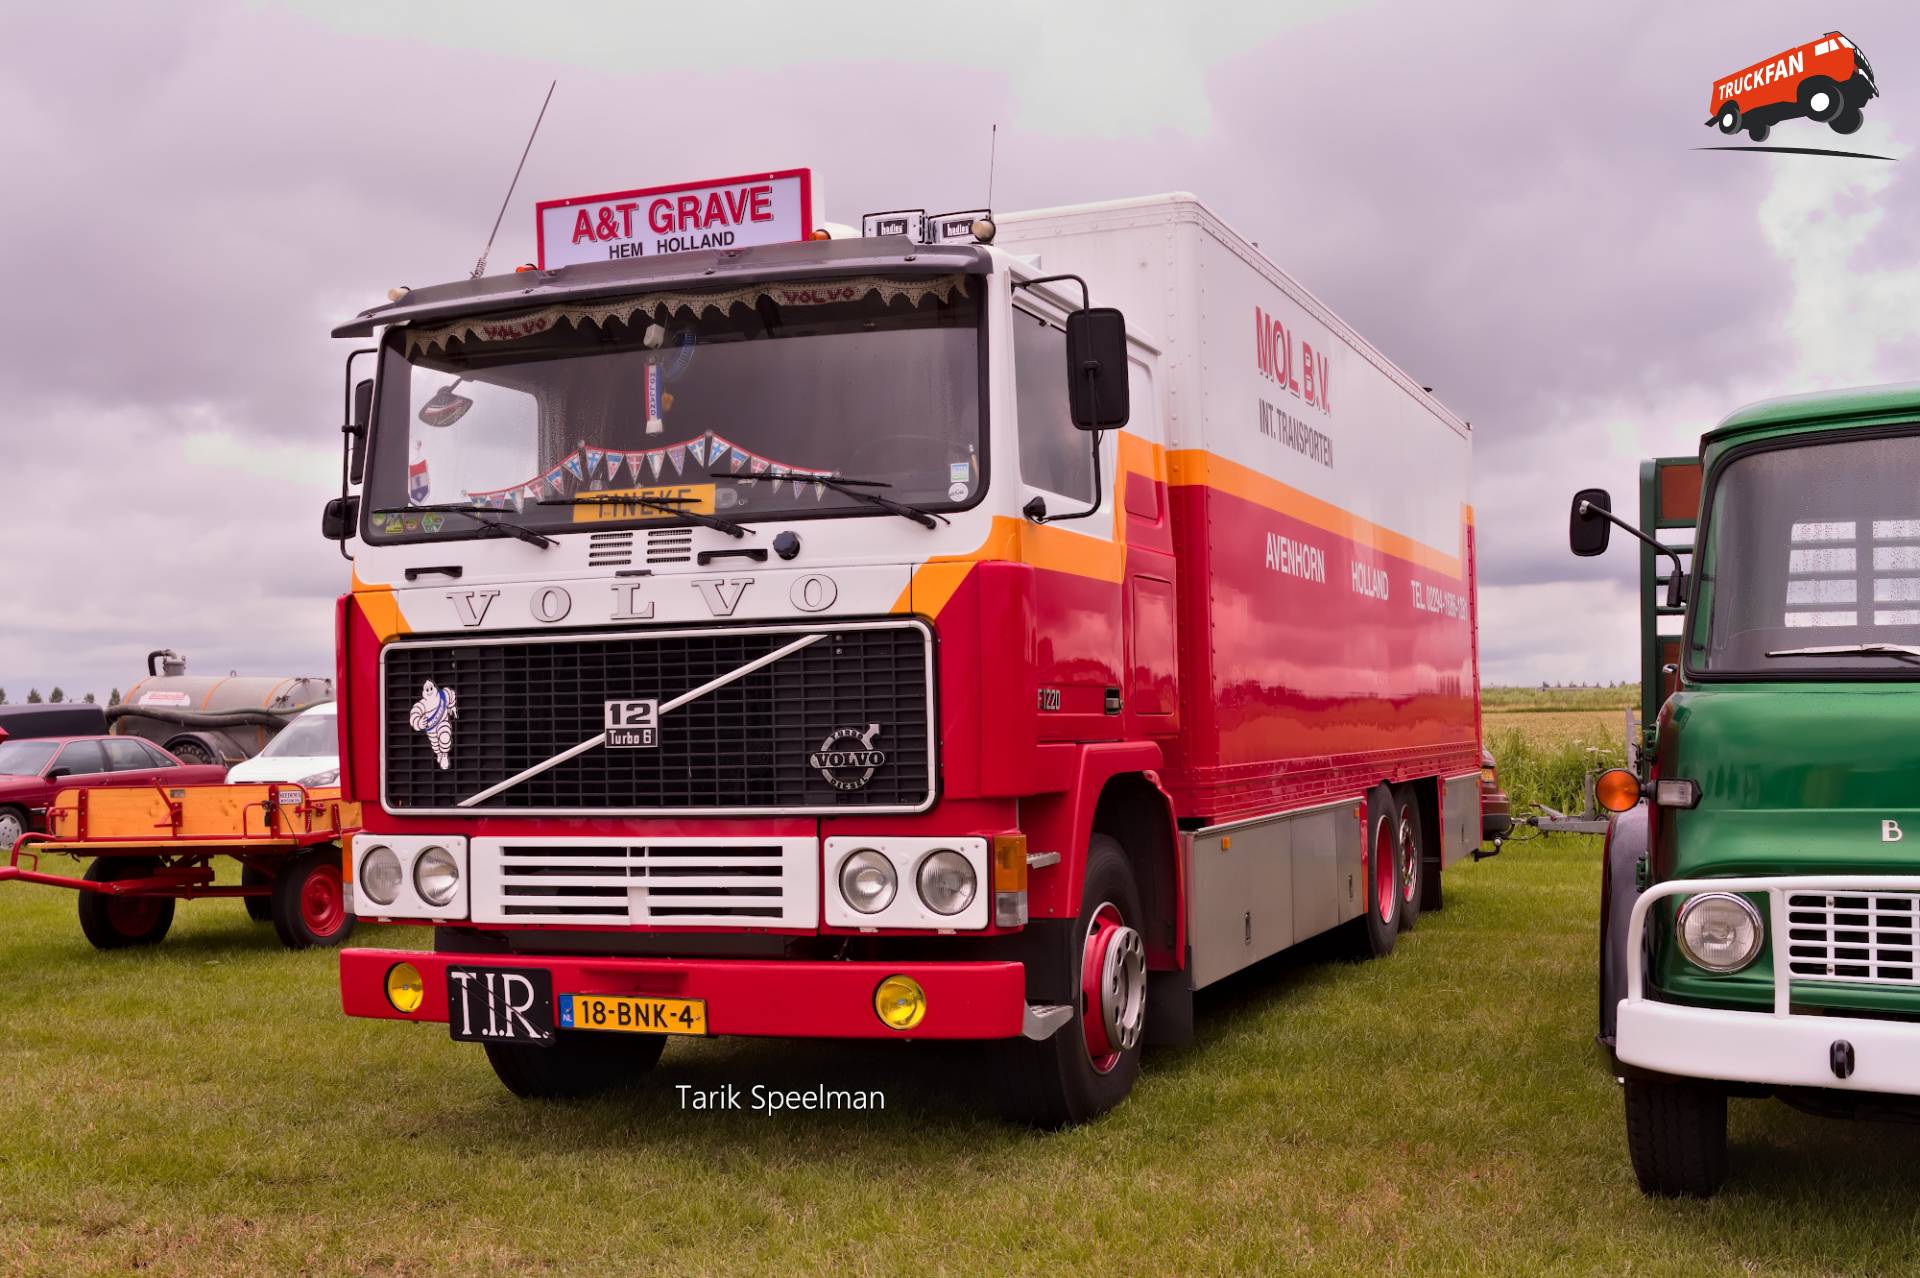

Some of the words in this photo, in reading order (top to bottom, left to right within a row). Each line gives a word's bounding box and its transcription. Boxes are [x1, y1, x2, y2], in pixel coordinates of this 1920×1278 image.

[572, 203, 639, 244] A&T
[648, 185, 774, 235] GRAVE
[609, 242, 643, 259] HEM
[657, 231, 735, 254] HOLLAND
[783, 287, 855, 304] VOLVO
[483, 318, 546, 339] VOLVO
[1256, 305, 1300, 398] MOL
[1259, 398, 1276, 439] INT.
[1276, 408, 1333, 469] TRANSPORTEN
[596, 487, 691, 518] TINEKE
[1266, 532, 1326, 584] AVENHORN
[1351, 560, 1389, 600] HOLLAND
[446, 574, 838, 626] VOLVO
[610, 703, 651, 725] 12
[609, 730, 640, 744] Turbo
[643, 730, 652, 744] 6
[816, 752, 884, 766] VOLVO
[1882, 819, 1903, 842] B
[562, 1014, 573, 1022] NL
[582, 1000, 694, 1029] 18-BNK-4
